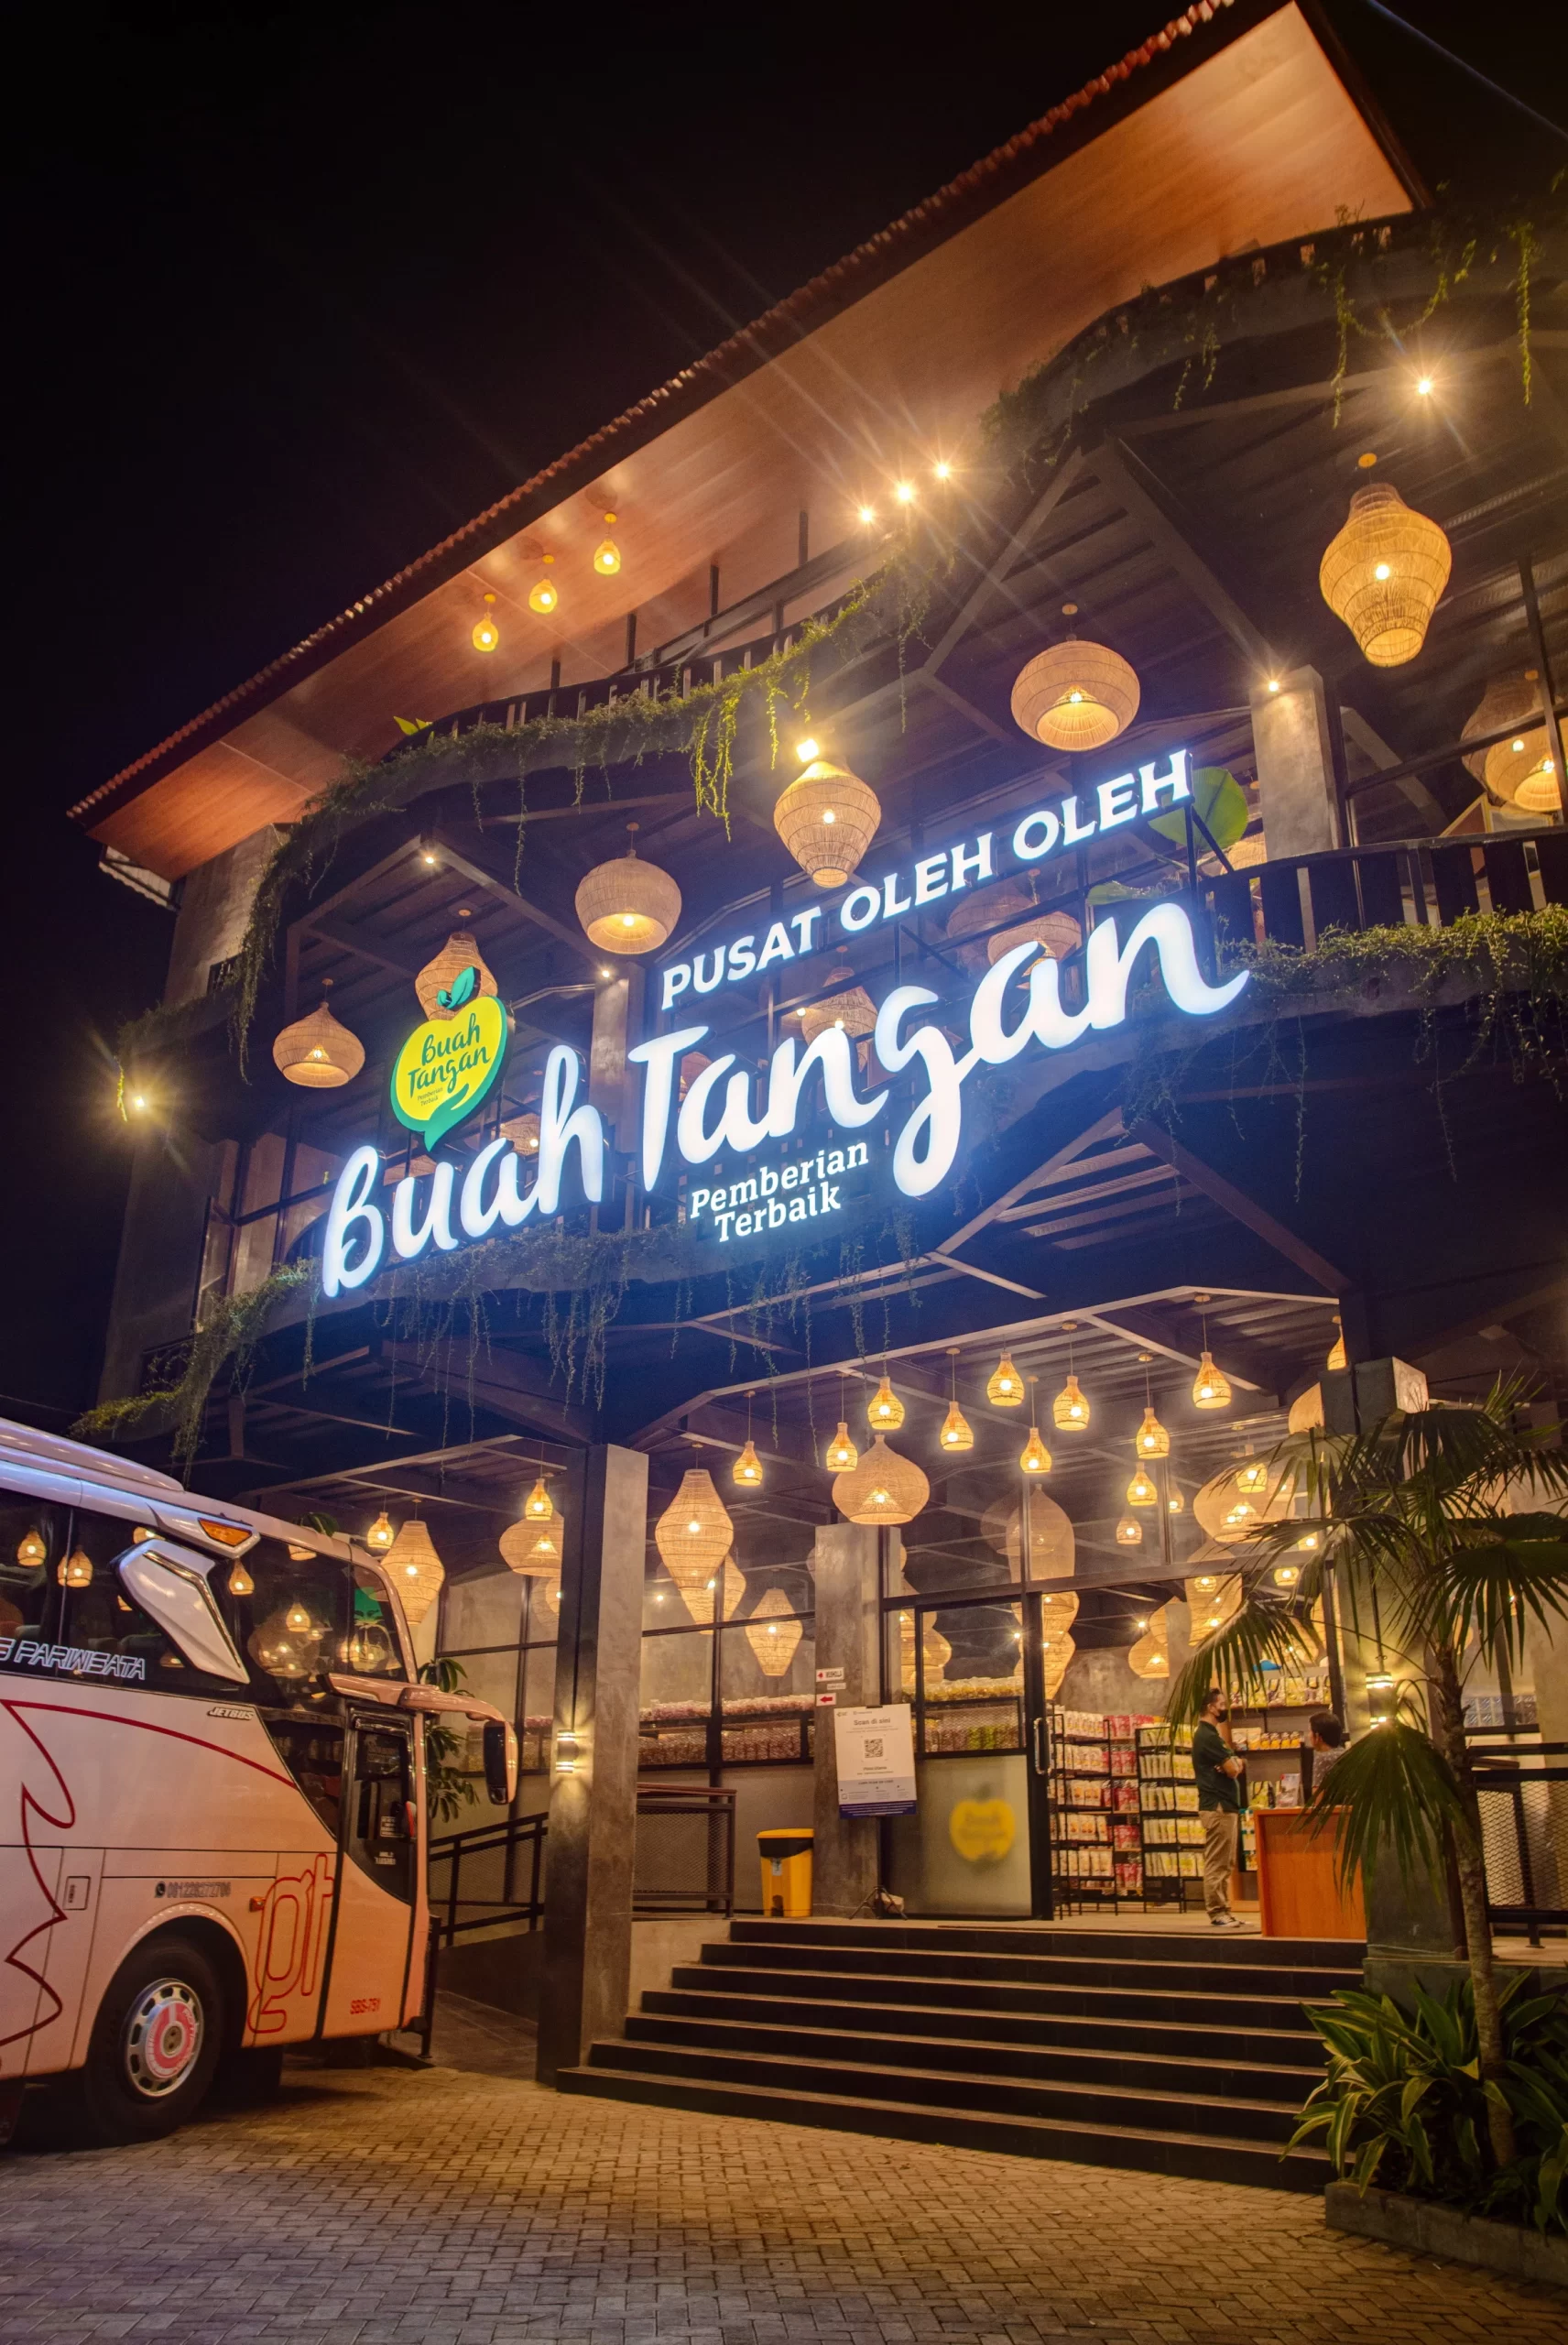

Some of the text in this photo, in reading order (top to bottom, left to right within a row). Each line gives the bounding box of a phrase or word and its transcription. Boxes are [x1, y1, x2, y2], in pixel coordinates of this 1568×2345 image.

[659, 748, 1192, 1011] PUSAT OLEH OLEH
[421, 1012, 481, 1066] Buah
[322, 903, 1250, 1298] Buah Tangan
[408, 1046, 491, 1098] Tangan
[690, 1142, 869, 1220] Pemberian
[714, 1183, 842, 1243] Terbaik
[13, 1640, 146, 1681] PARIWISATA
[208, 1707, 255, 1720] JETBUS
